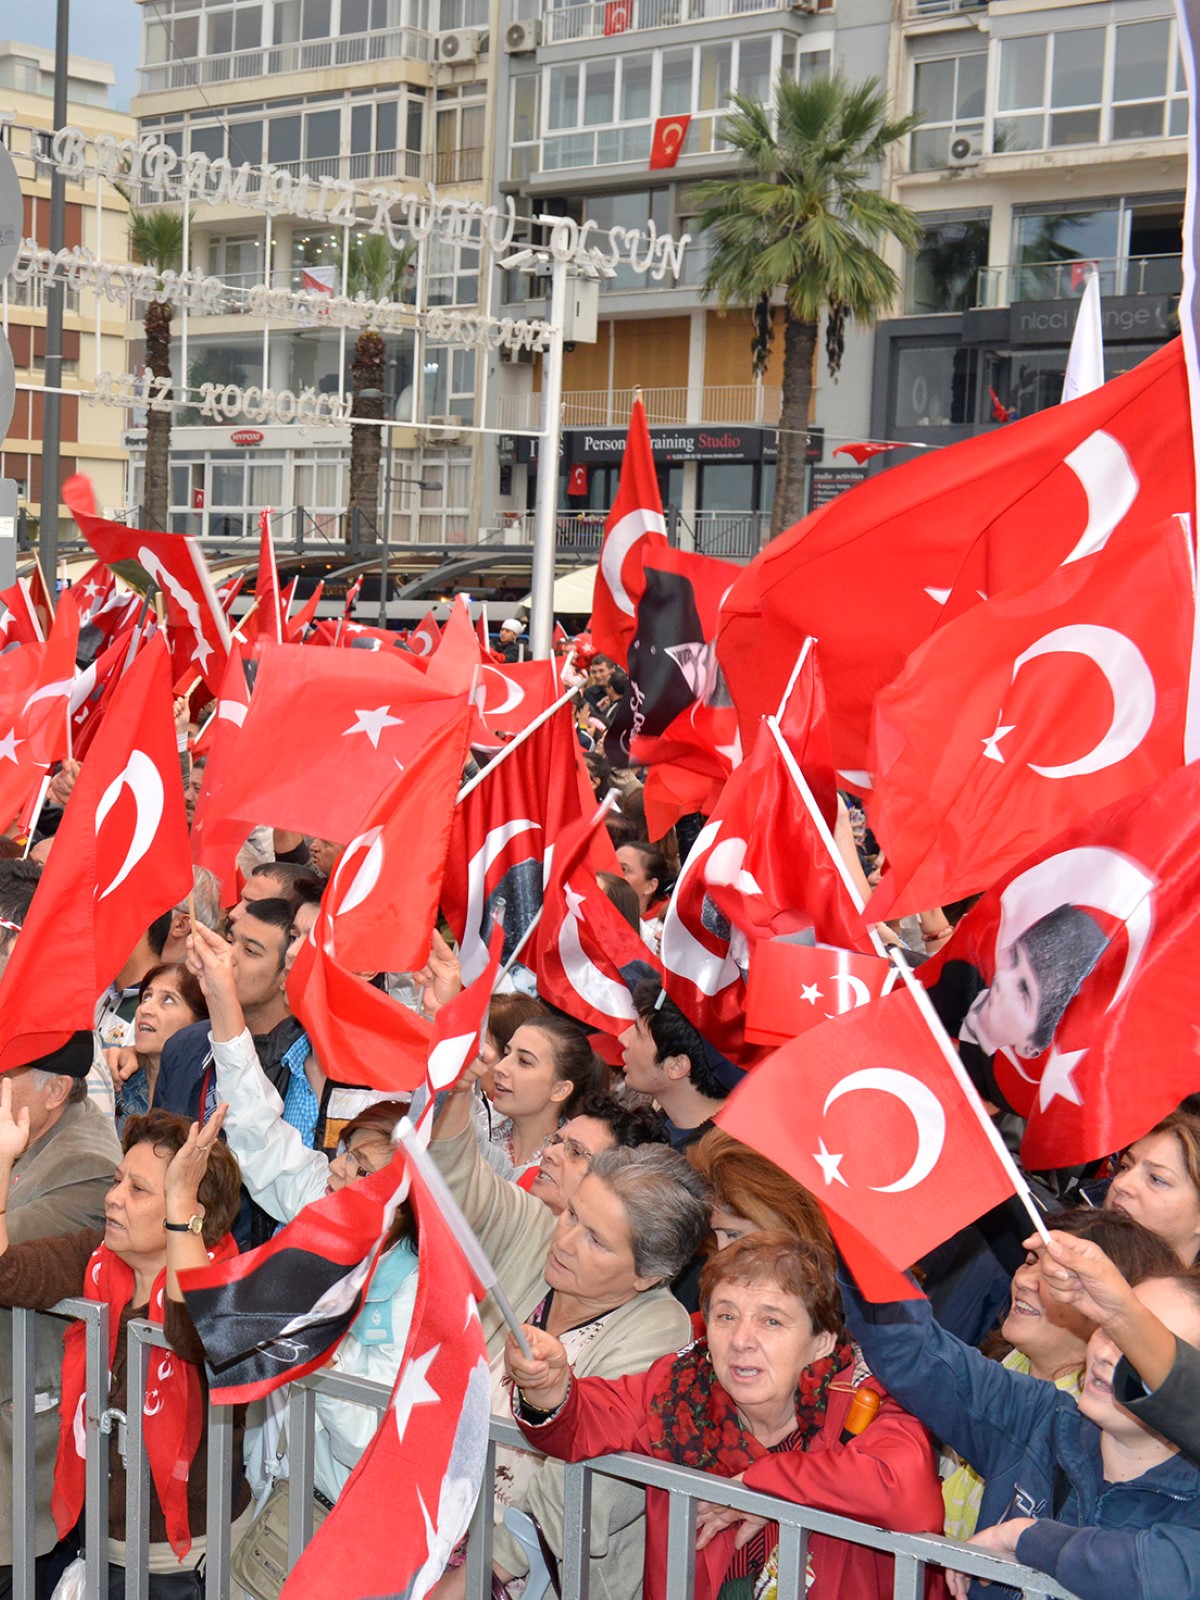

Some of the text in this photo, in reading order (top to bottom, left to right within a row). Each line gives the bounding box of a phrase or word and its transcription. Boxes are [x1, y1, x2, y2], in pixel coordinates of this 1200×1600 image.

[368, 182, 517, 252] KUTLU
[550, 216, 693, 281] OLSUN
[1020, 310, 1068, 330] nicci
[89, 366, 174, 412] AZİZ
[584, 432, 742, 452] Person raining Studio
